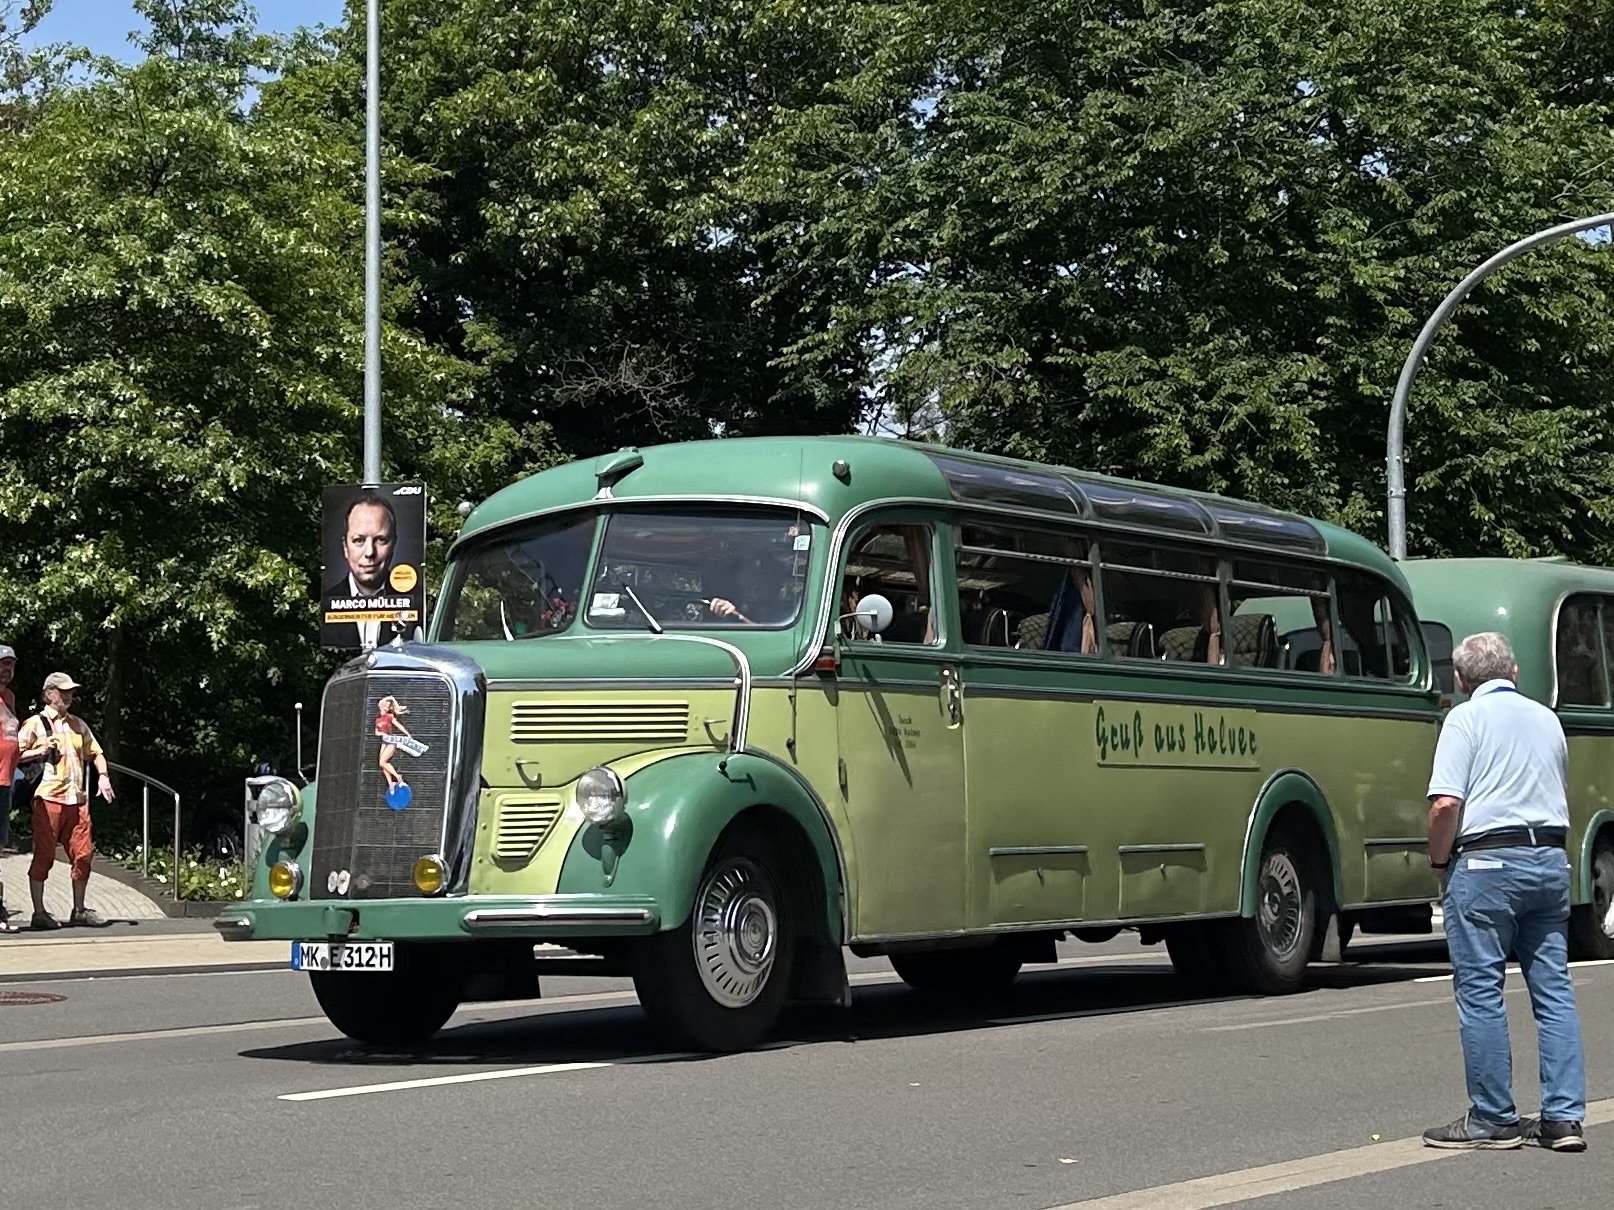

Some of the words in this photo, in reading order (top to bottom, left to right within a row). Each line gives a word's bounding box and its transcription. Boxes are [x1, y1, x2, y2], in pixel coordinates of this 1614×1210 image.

[399, 486, 422, 495] CDU
[331, 599, 367, 609] MARCO
[368, 596, 411, 609] MÜLLER
[1096, 706, 1144, 761] Gruß
[1155, 723, 1186, 753] aus
[1194, 711, 1257, 756] Halver
